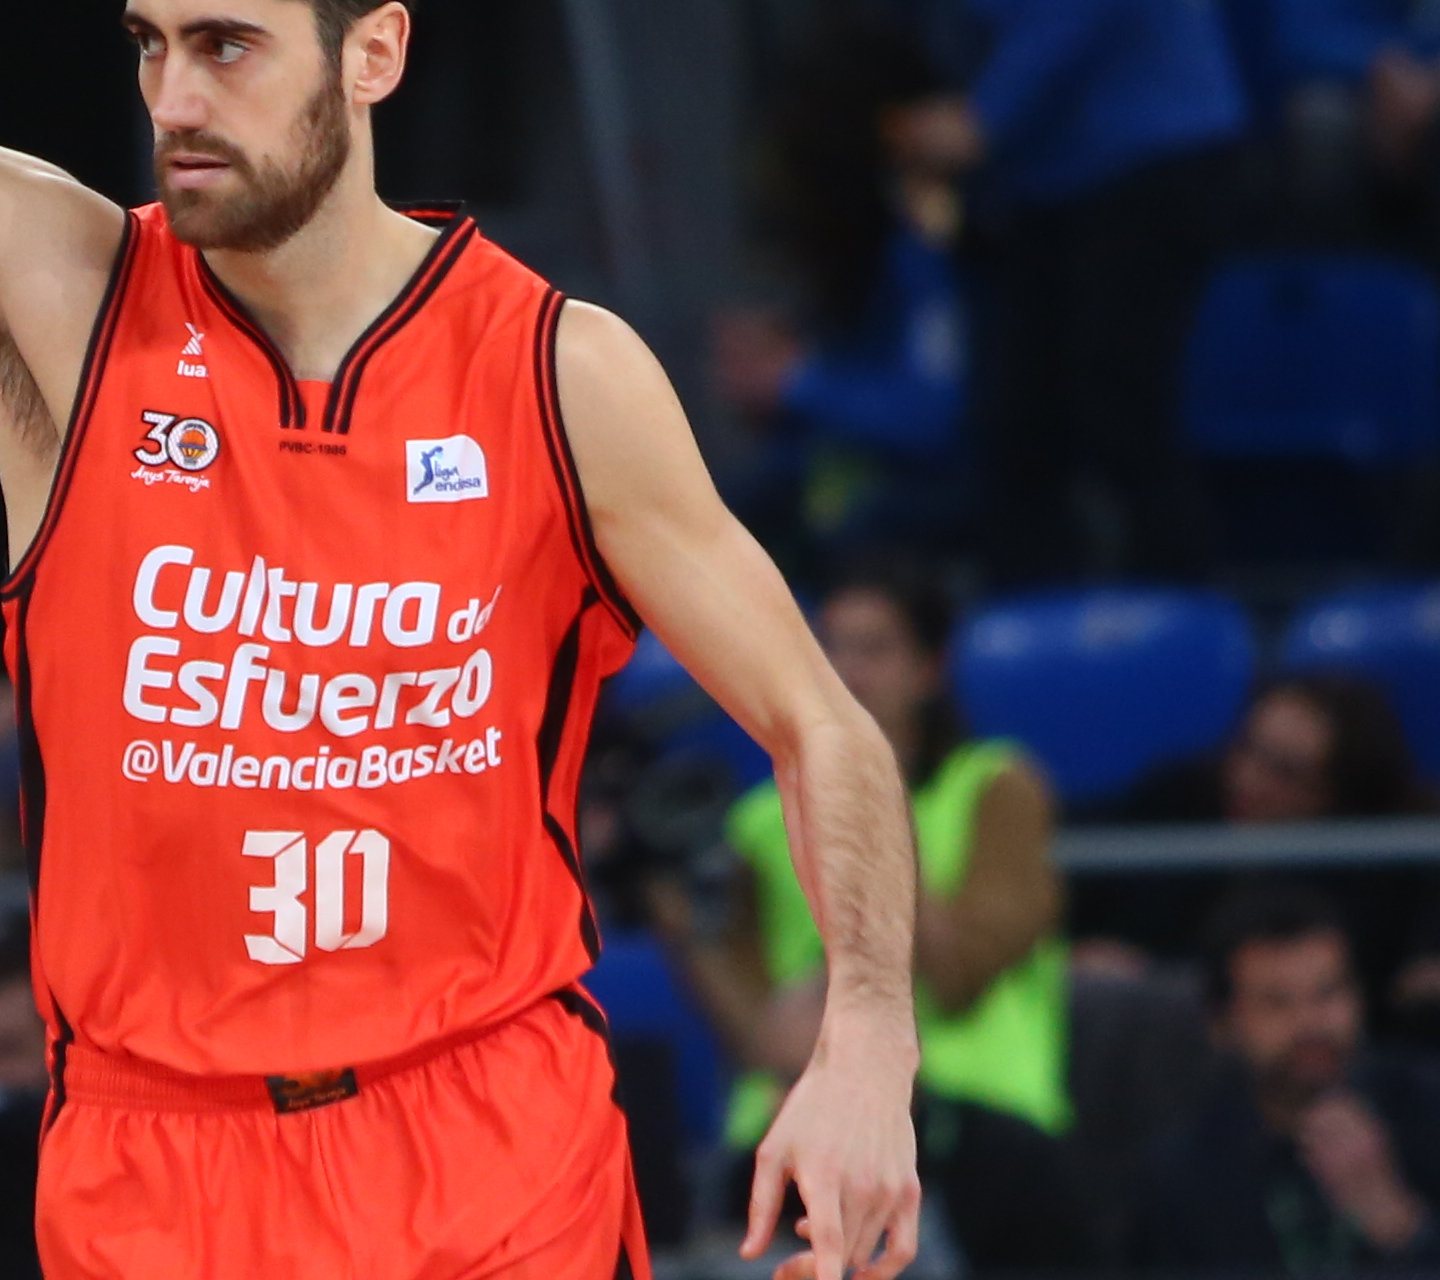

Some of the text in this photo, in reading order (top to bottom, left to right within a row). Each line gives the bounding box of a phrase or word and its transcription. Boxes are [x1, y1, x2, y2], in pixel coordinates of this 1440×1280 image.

[177, 360, 209, 378] lua
[133, 409, 219, 470] 30
[132, 545, 441, 648] Cultura
[122, 635, 493, 737] Esfuerzo
[122, 726, 503, 791] @ValenciaBasket
[241, 829, 390, 966] 30
